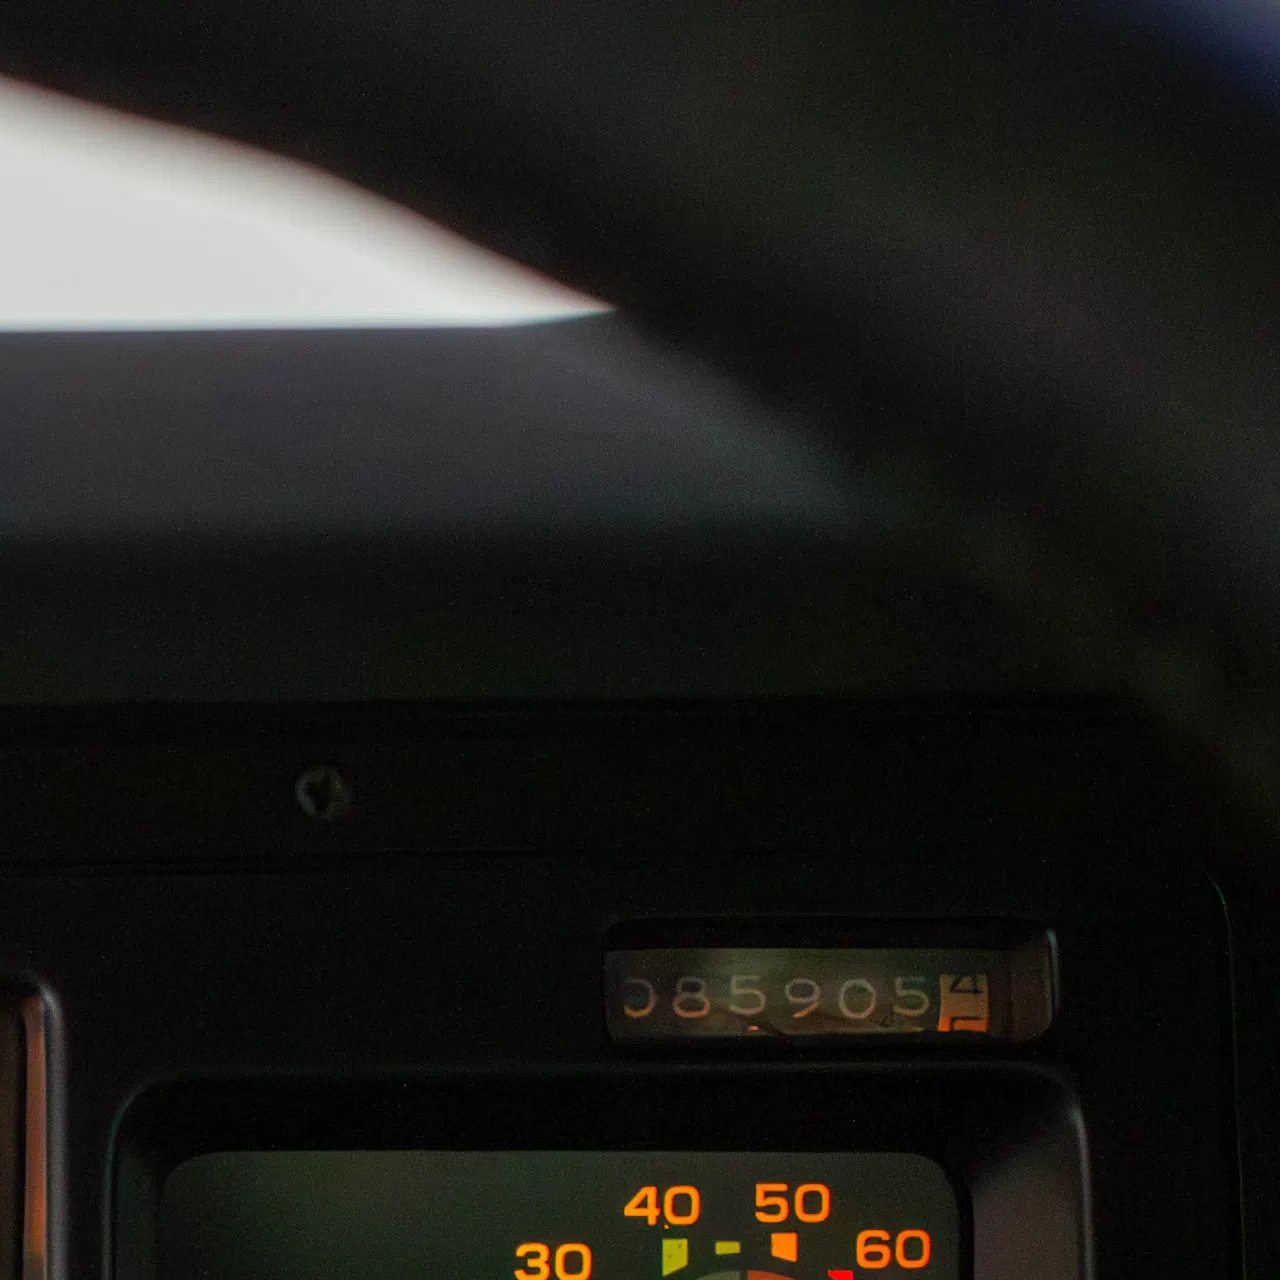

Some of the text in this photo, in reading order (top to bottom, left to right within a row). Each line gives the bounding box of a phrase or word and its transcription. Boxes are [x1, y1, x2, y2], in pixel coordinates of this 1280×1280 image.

[624, 1184, 701, 1226] 40
[755, 1183, 831, 1223] 50
[855, 1229, 931, 1269] 60
